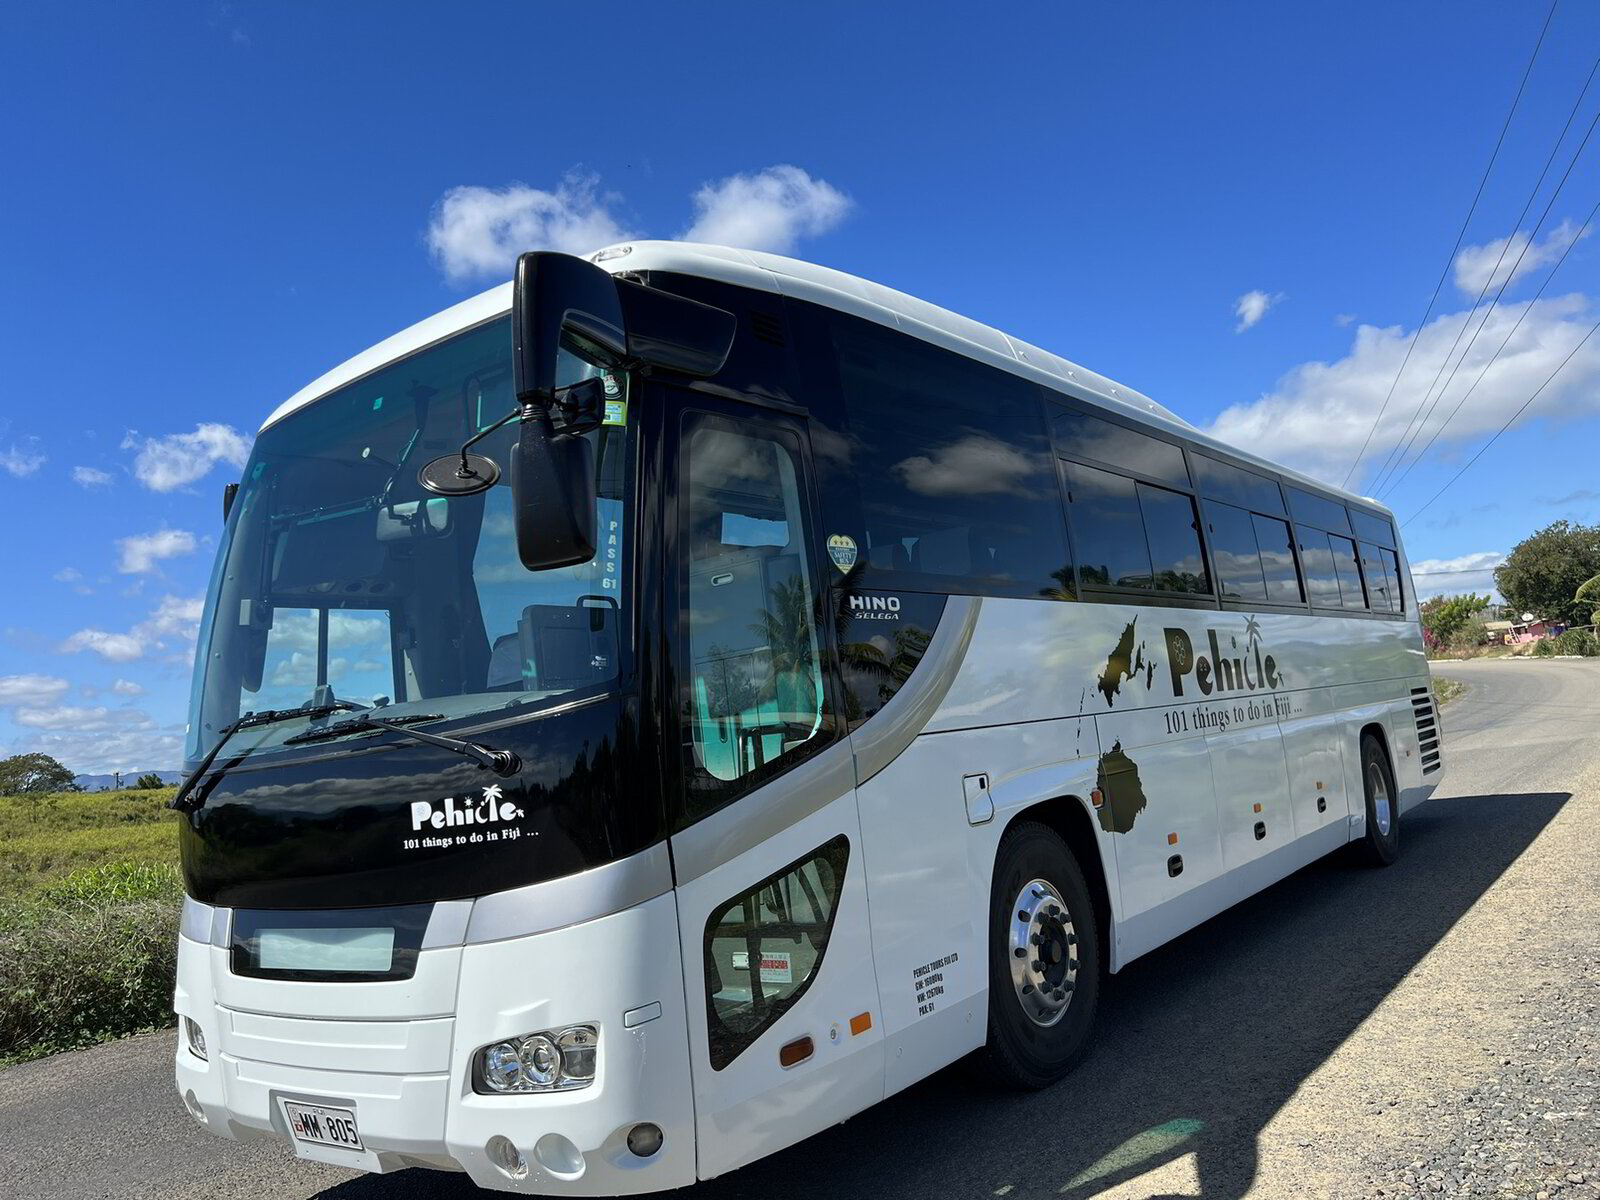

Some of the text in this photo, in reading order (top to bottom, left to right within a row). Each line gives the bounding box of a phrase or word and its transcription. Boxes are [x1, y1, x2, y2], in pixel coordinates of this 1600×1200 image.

[602, 520, 618, 590] PASS 61
[849, 595, 901, 612] HINO
[1163, 614, 1284, 697] Pehicle
[1163, 709, 1189, 735] 101
[1193, 706, 1231, 732] things
[1232, 704, 1245, 723] to
[1248, 699, 1262, 721] do
[1263, 698, 1273, 718] in
[1274, 696, 1292, 721] Fiji
[411, 784, 525, 831] Pehicle
[403, 839, 420, 850] 101
[422, 835, 453, 848] things
[455, 835, 467, 845] to
[469, 832, 484, 842] do
[486, 831, 499, 841] in
[501, 827, 521, 841] Fiji
